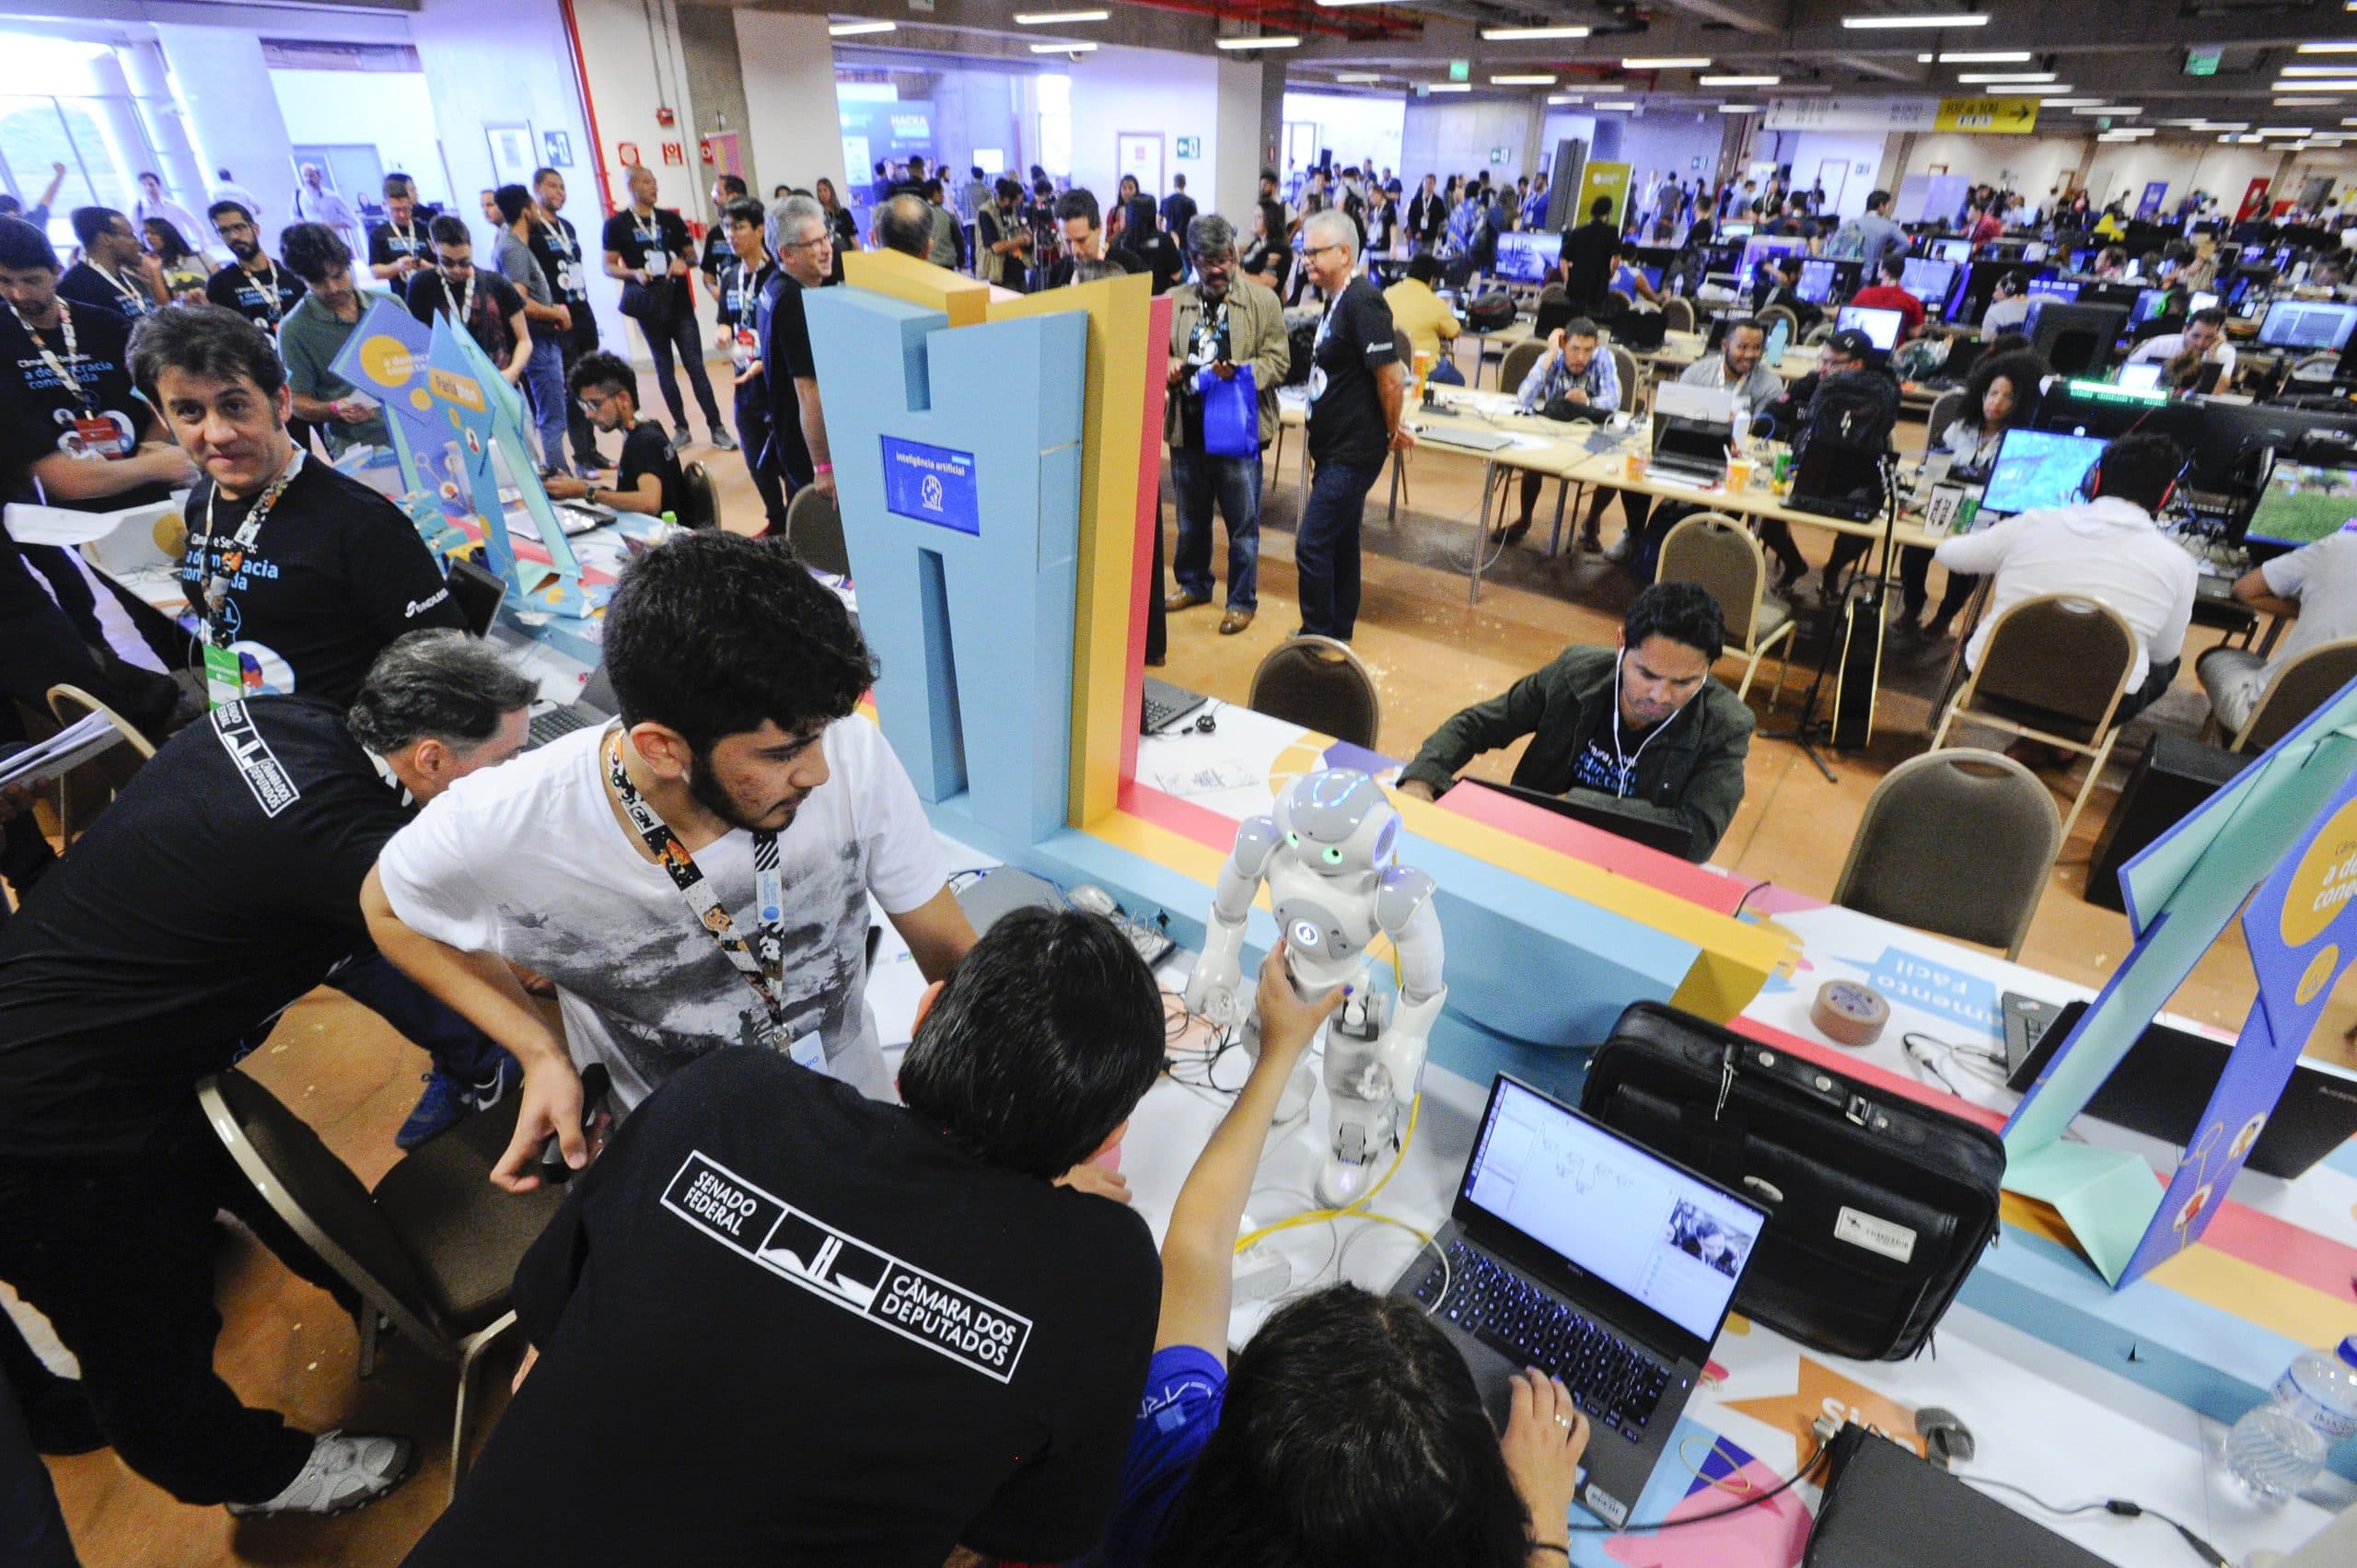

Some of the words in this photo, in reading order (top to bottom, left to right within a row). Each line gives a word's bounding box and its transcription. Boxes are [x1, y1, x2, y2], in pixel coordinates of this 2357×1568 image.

[2323, 865, 2339, 887] a
[683, 1186, 744, 1237] FEDERAL
[693, 1170, 758, 1218] SENADO
[880, 1292, 1008, 1366] DEPUTADOS
[892, 1274, 972, 1328] CÂMARA
[973, 1310, 1017, 1347] DOS
